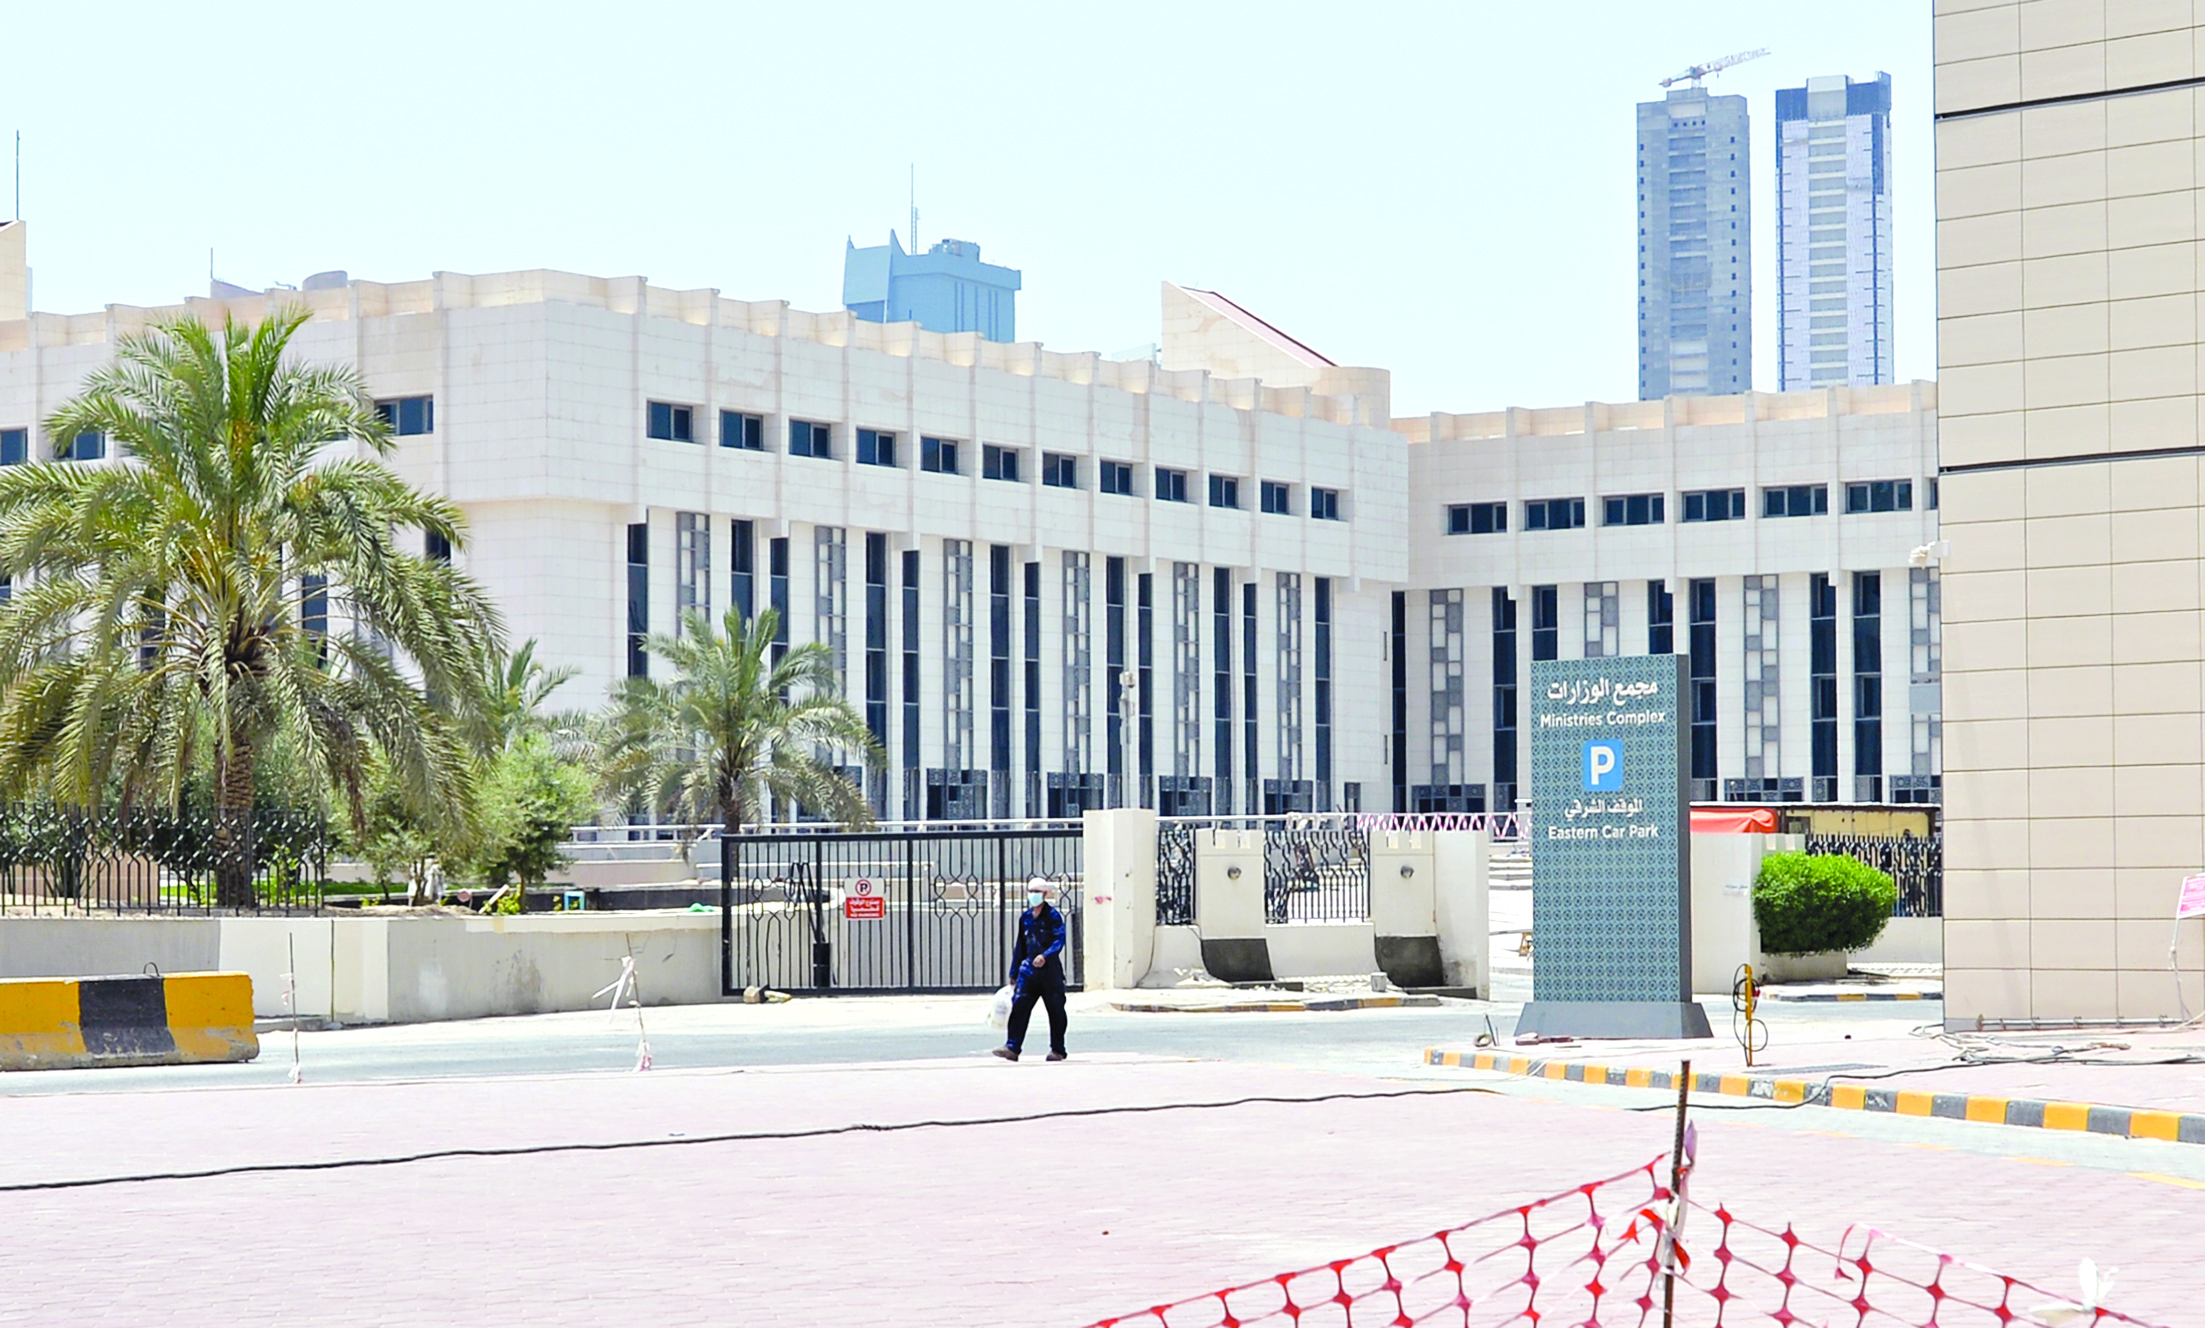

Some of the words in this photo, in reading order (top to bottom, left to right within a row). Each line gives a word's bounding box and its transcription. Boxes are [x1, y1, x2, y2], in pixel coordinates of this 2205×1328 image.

[1547, 677, 1609, 705] الوزارات
[1613, 680, 1658, 706] مجمع
[1540, 712, 1602, 728] Ministries
[1606, 709, 1665, 726] Complex
[1590, 745, 1615, 785] P
[1564, 798, 1605, 821] الشرقي
[1548, 826, 1598, 840] Eastern
[1602, 825, 1625, 839] Car
[1629, 824, 1659, 838] Park
